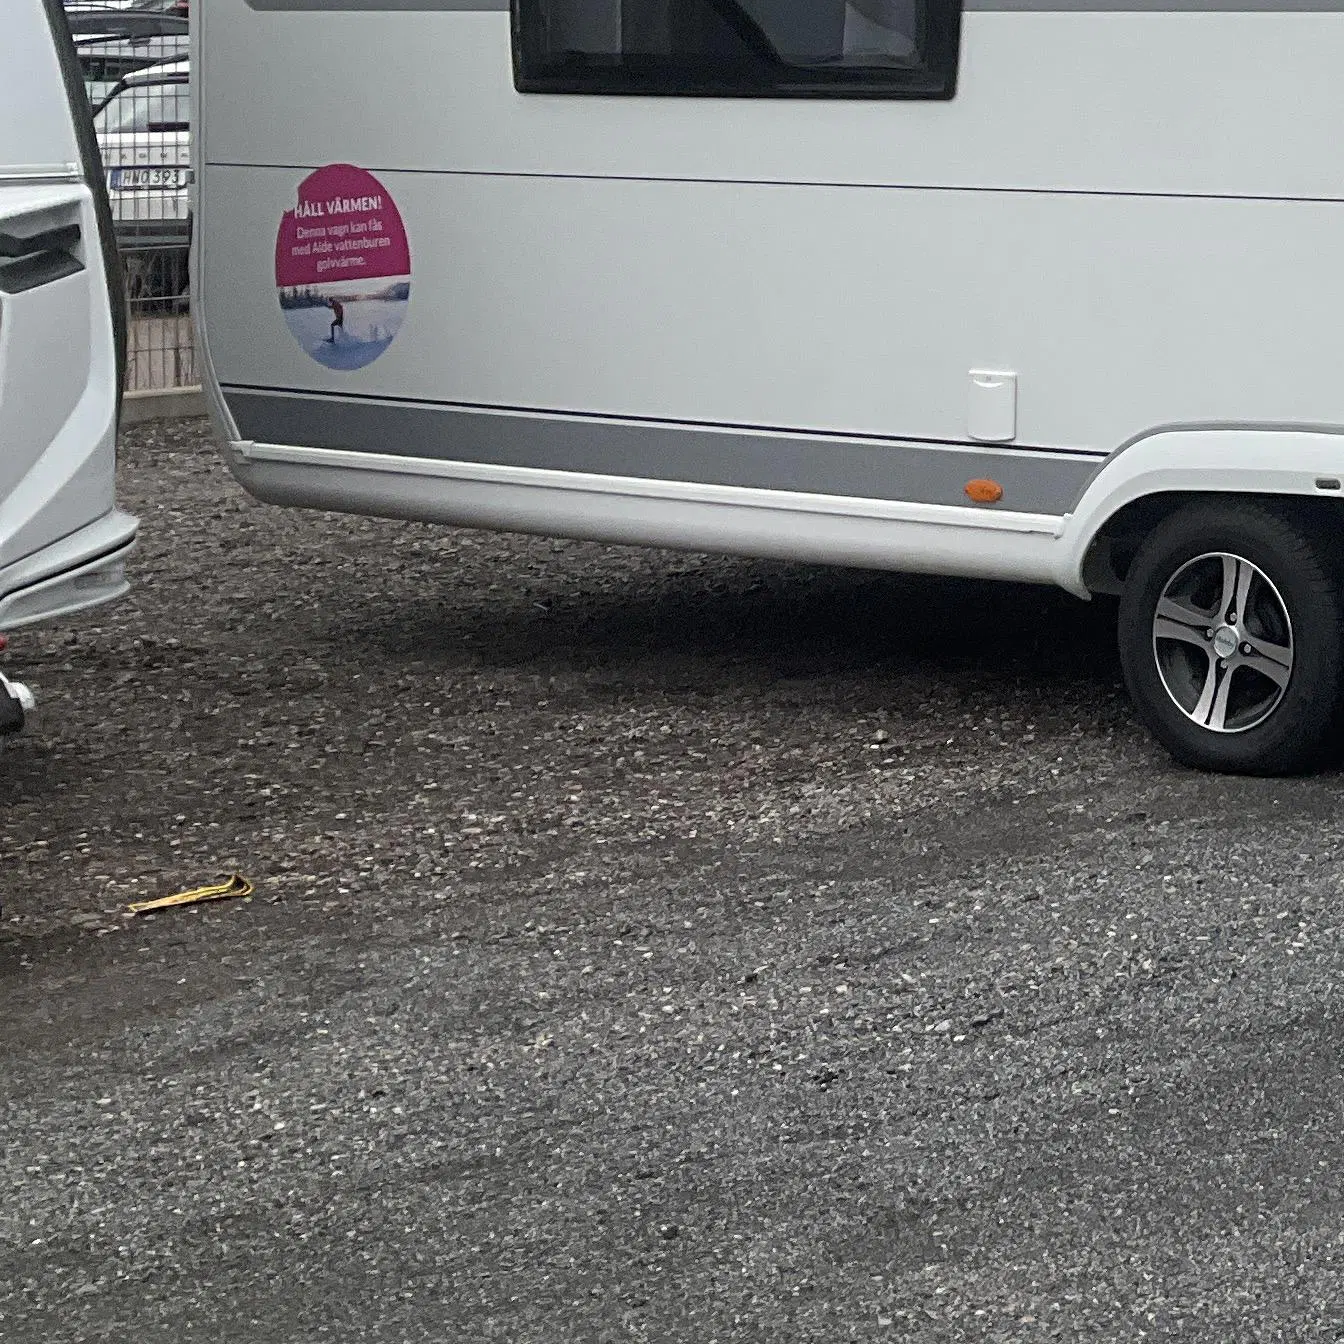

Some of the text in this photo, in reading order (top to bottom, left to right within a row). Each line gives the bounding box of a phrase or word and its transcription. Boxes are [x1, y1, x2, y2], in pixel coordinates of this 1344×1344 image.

[294, 195, 383, 219] HÅLL VÄRMEN!
[327, 223, 349, 237] vagn
[350, 220, 367, 234] kan
[368, 217, 383, 232] fås
[291, 243, 311, 256] med
[333, 235, 391, 252] vattenburen
